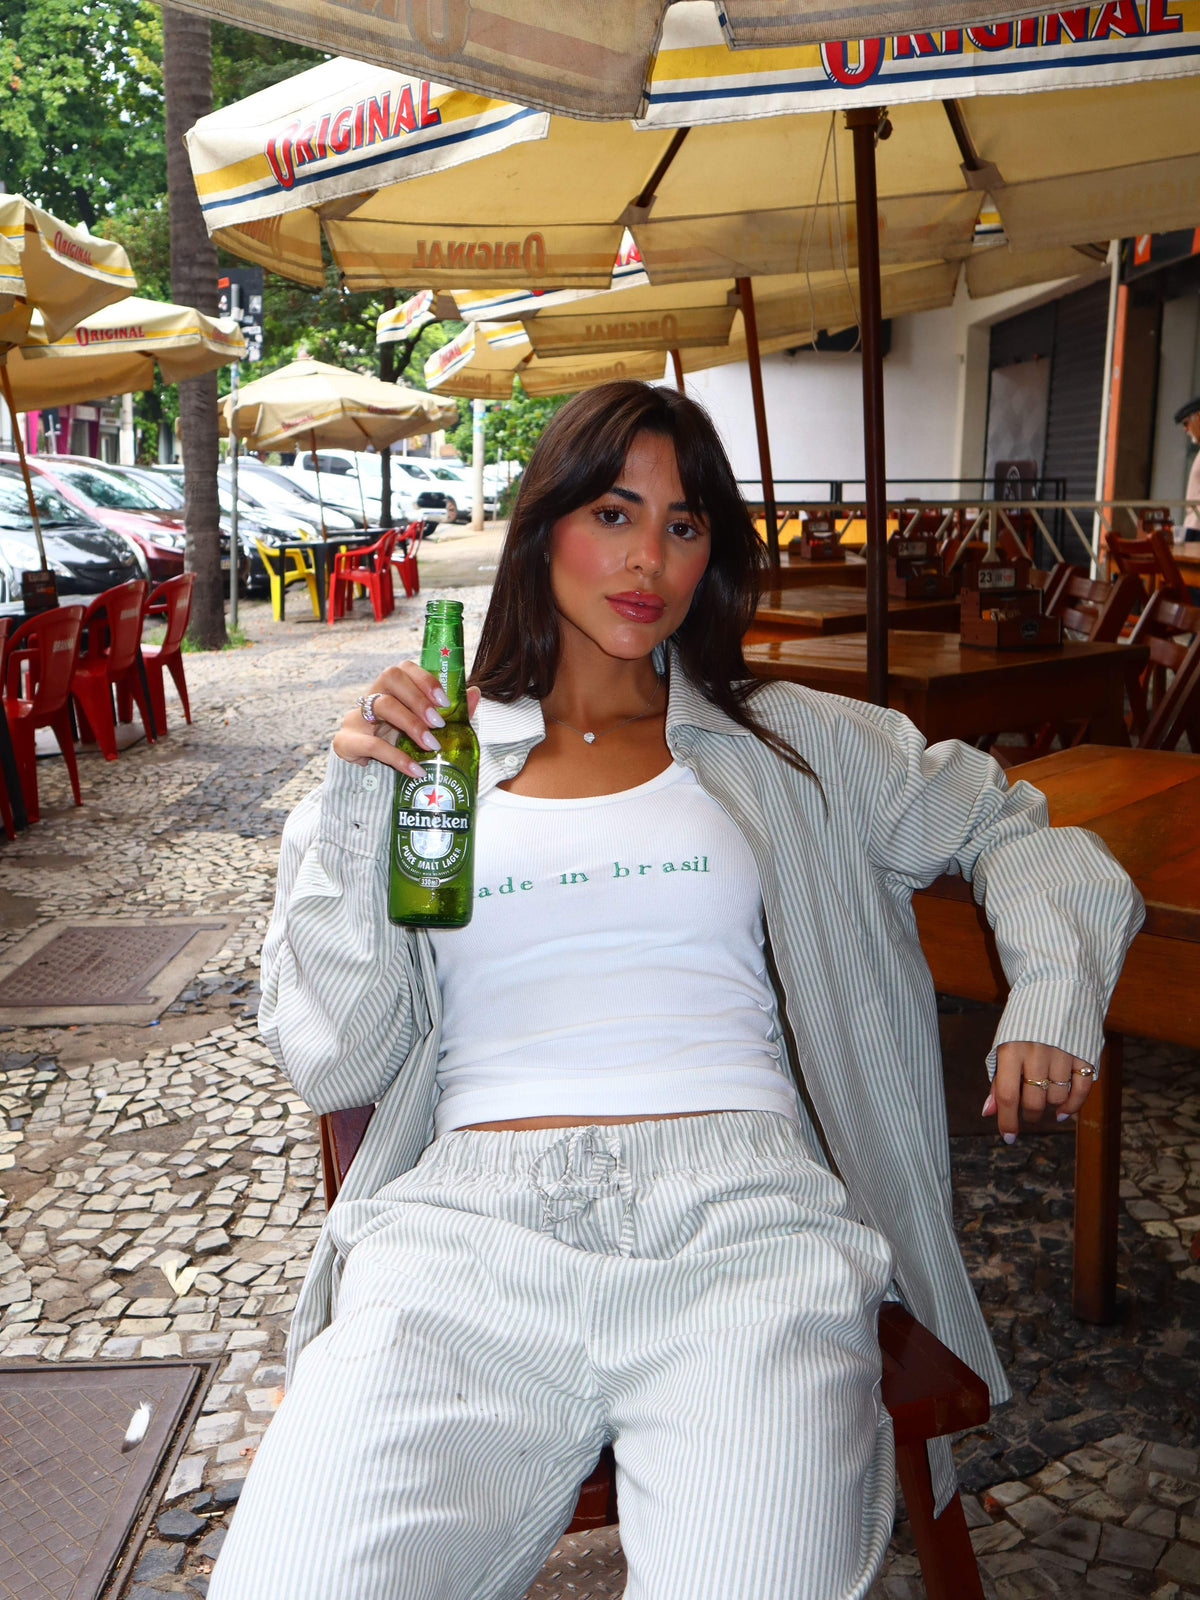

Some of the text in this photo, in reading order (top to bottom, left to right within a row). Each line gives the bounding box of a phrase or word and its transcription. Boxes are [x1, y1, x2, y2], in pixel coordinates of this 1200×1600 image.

[265, 80, 441, 191] ORIGINAL
[53, 231, 92, 266] ORIGINAL
[76, 327, 145, 346] ORIGINAL
[979, 571, 993, 584] 23
[439, 660, 448, 693] neken
[438, 774, 465, 804] ORIGINAL
[398, 811, 468, 829] Heineken
[402, 845, 417, 866] PURE
[417, 861, 440, 871] MALT
[442, 847, 462, 869] LAGER
[474, 856, 710, 899] ade in brasil
